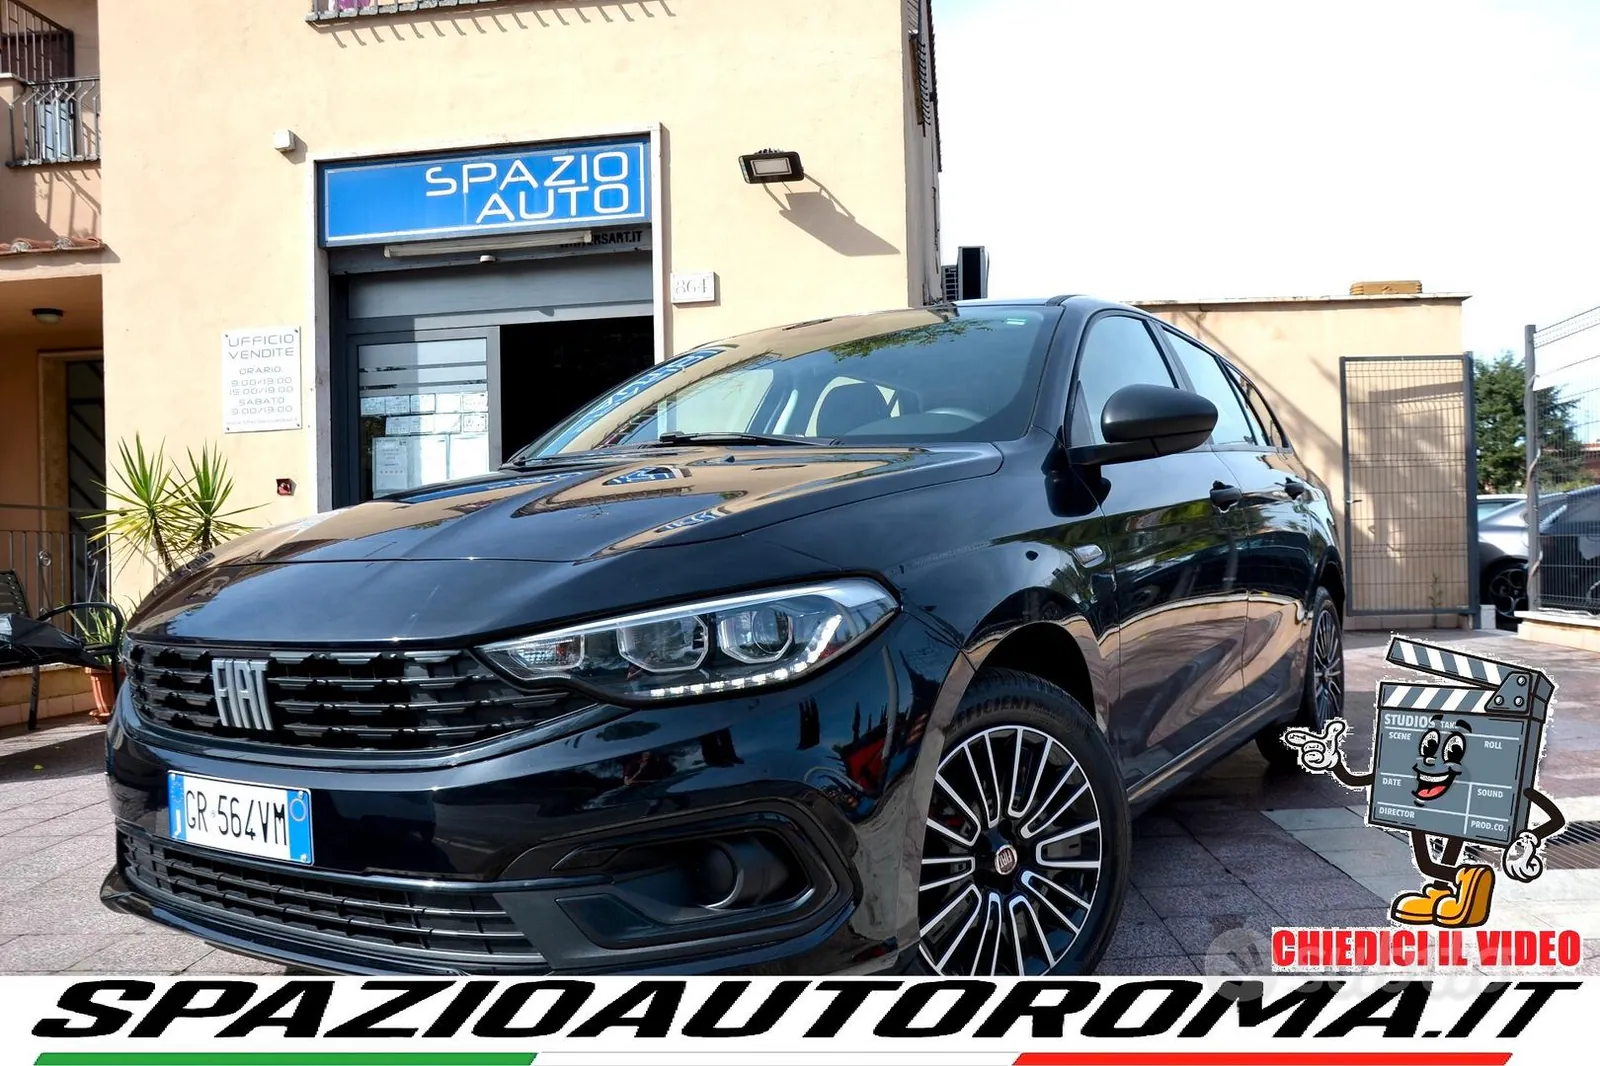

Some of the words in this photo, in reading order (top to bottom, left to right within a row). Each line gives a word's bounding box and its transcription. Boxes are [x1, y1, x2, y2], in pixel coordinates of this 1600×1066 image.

[425, 151, 629, 197] SPAZIO
[475, 183, 629, 224] AUTO
[675, 278, 709, 295] 864
[228, 333, 294, 348] UFFICIO
[228, 347, 294, 360] VENDITE
[239, 396, 285, 407] SABATO
[211, 658, 275, 731] FIAT
[185, 790, 208, 832] GR
